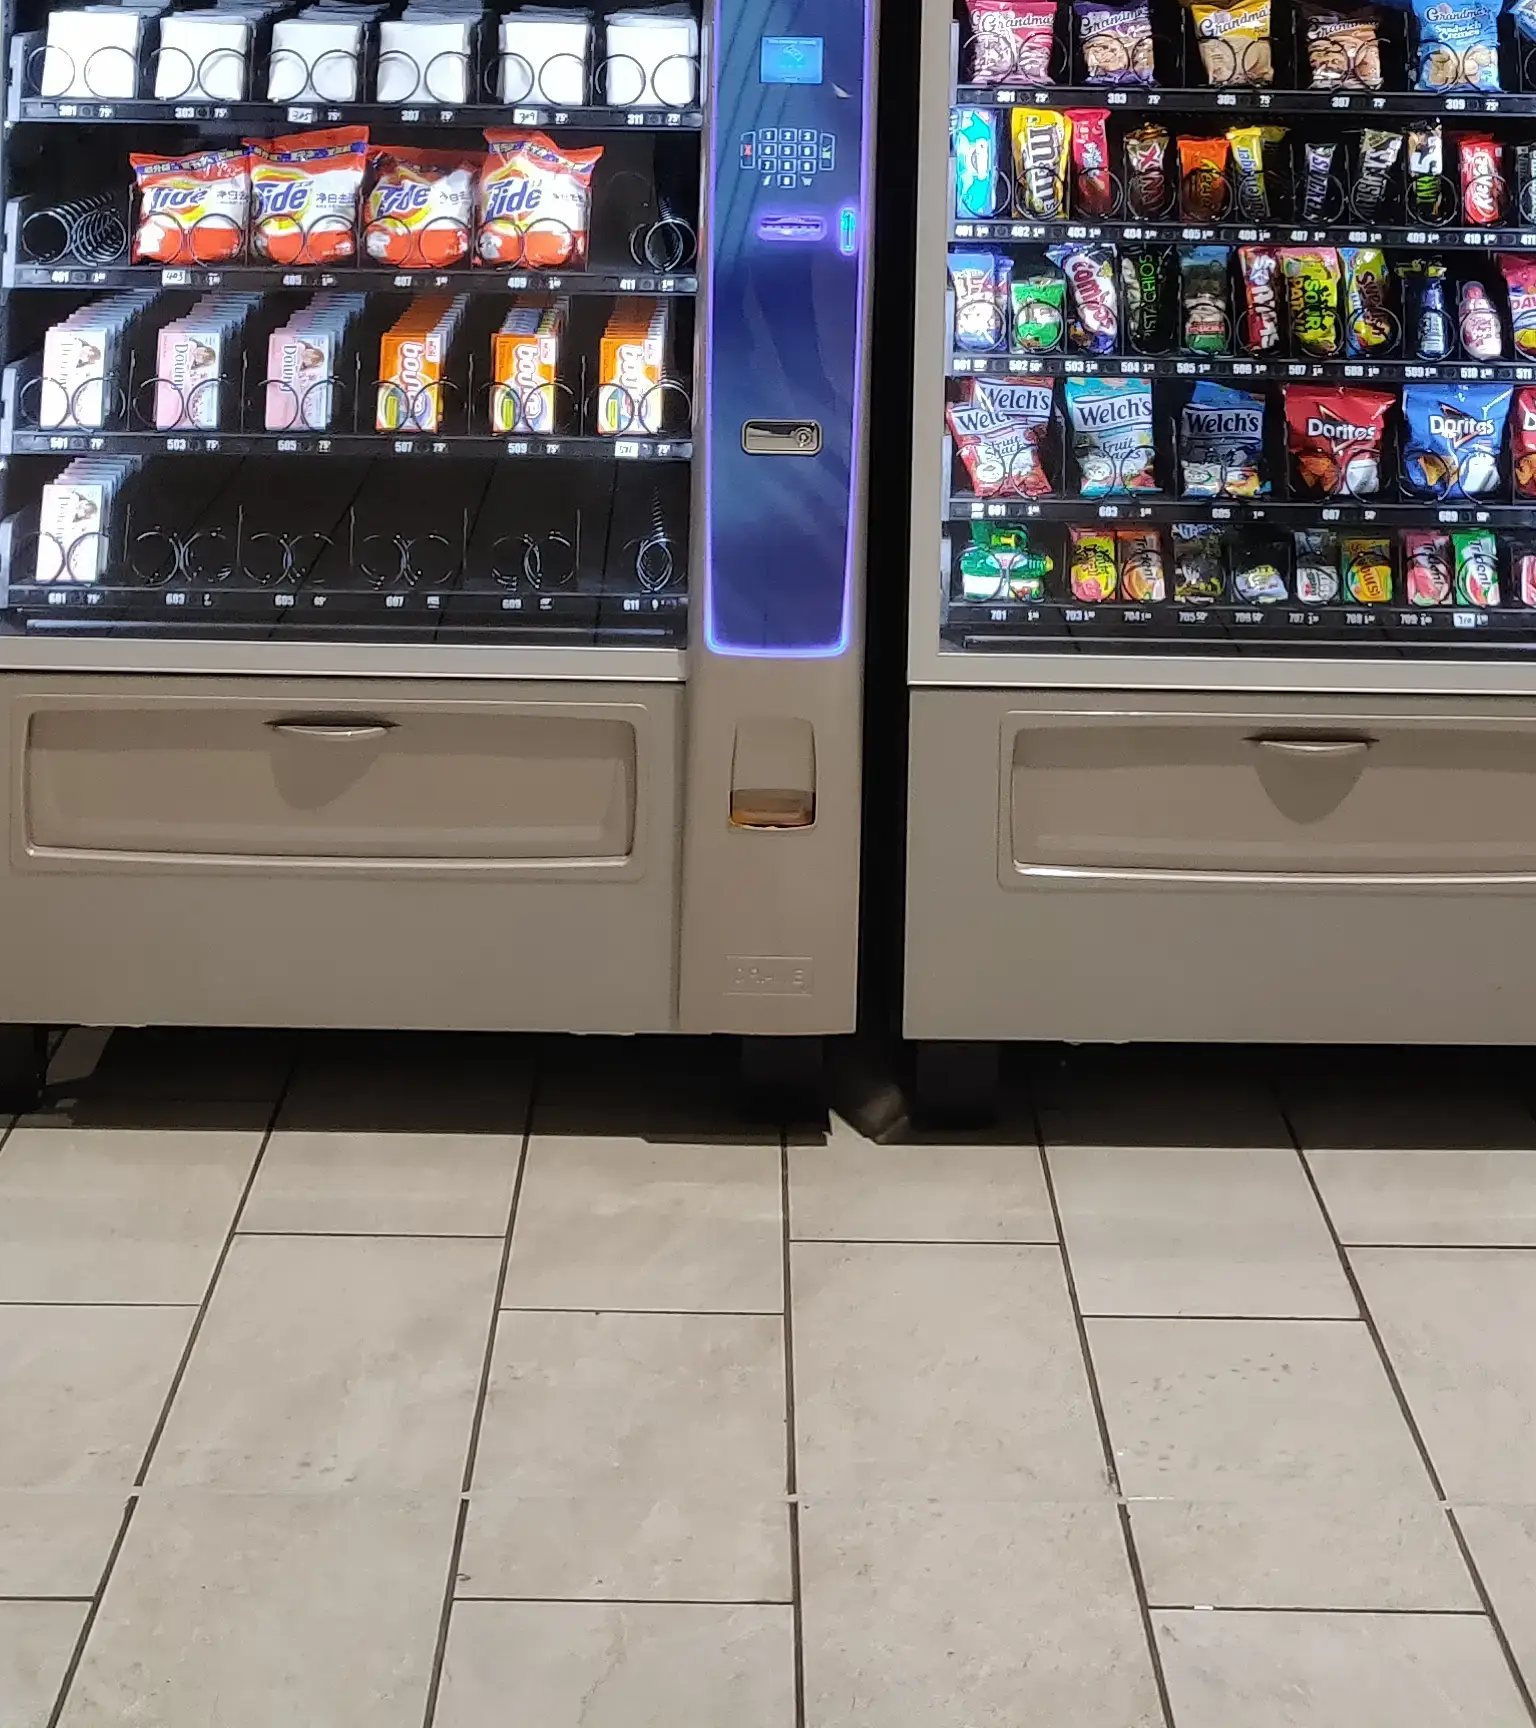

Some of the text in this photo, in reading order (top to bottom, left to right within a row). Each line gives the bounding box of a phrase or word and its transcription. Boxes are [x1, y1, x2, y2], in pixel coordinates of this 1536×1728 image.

[1435, 21, 1482, 34] Sandwich
[1438, 29, 1481, 42] Cremes
[1446, 99, 1466, 111] 309
[175, 107, 194, 119] 303
[627, 114, 644, 125] 311
[485, 180, 542, 221] Tide
[1067, 227, 1086, 237] 403
[508, 277, 527, 289] 409
[620, 279, 635, 290] 411
[1302, 278, 1327, 332] SOUR
[170, 343, 189, 394] Downy
[1065, 361, 1084, 371] 503
[1121, 362, 1139, 372] 504
[1177, 363, 1196, 374] 505
[1289, 365, 1307, 375] 507
[1405, 366, 1424, 377] 509
[1079, 397, 1153, 426] Welch's
[1185, 411, 1260, 433] Welch's
[1429, 415, 1496, 437] Doritos
[1307, 418, 1378, 441] Doritos
[167, 438, 186, 450] 503
[395, 442, 413, 454] 507
[508, 442, 527, 454] 509
[1102, 438, 1136, 452] Fruit
[1470, 538, 1494, 587] Trident
[991, 611, 1007, 621] 701
[1066, 610, 1082, 621] 703
[1124, 611, 1140, 622] 704
